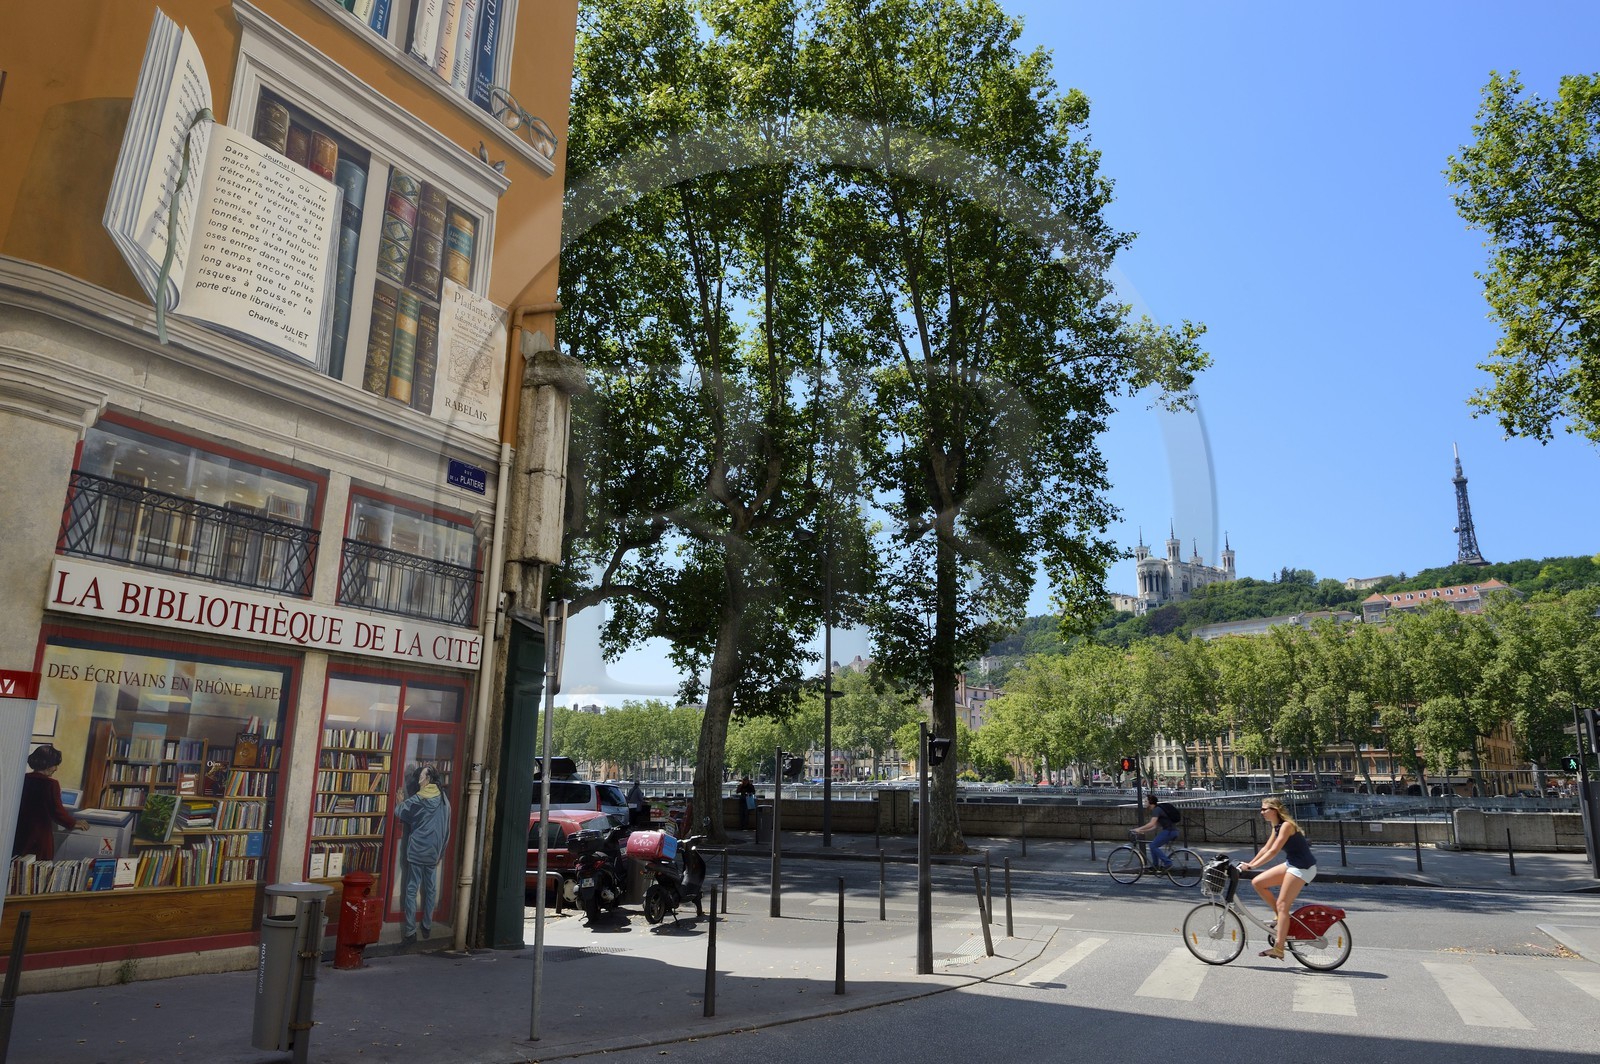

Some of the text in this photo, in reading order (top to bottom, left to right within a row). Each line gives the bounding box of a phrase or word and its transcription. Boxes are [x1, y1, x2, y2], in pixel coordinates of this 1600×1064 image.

[446, 0, 456, 17] LA
[484, 15, 494, 56] Bernard
[438, 46, 448, 70] 1941
[224, 145, 249, 160] Dans
[275, 171, 291, 182] rue
[299, 184, 310, 193] où
[318, 194, 327, 202] tu
[264, 152, 290, 169] Journal
[217, 175, 251, 193] instant
[267, 198, 300, 219] vérifies
[315, 224, 323, 232] ta
[220, 165, 244, 179] d'être
[246, 177, 263, 188] pris
[266, 186, 276, 195] en
[302, 204, 307, 212] à
[309, 209, 325, 222] tout
[222, 156, 260, 177] marches
[264, 175, 284, 189] avec
[287, 186, 294, 195] la
[298, 193, 326, 212] crainte
[213, 198, 252, 216] chemise
[256, 214, 276, 227] sont
[279, 225, 298, 239] bien
[215, 187, 321, 242] veste et le col de ta
[206, 231, 227, 242] oses
[230, 238, 257, 252] entrer
[259, 250, 280, 264] dans
[283, 262, 294, 271] un
[208, 219, 317, 272] long temps avant que tu
[250, 223, 259, 231] et
[272, 232, 282, 242] t'a
[286, 239, 305, 254] fallu
[308, 253, 319, 262] un
[201, 255, 314, 304] long avant que tu ne te
[220, 248, 252, 263] temps
[256, 261, 290, 280] encore
[294, 279, 315, 294] plus
[196, 280, 286, 316] porte d'une librairie.
[198, 268, 312, 316] risques à pousser la
[248, 309, 309, 341] Charles JULIET
[445, 397, 488, 422] RABELAIS
[53, 571, 480, 665] LA BIBLIOTHÈQUE DE LA CITÉ
[47, 663, 79, 681] DES
[84, 664, 166, 690] ÉCRIVAINS
[171, 676, 190, 691] EN
[101, 838, 114, 850] X
